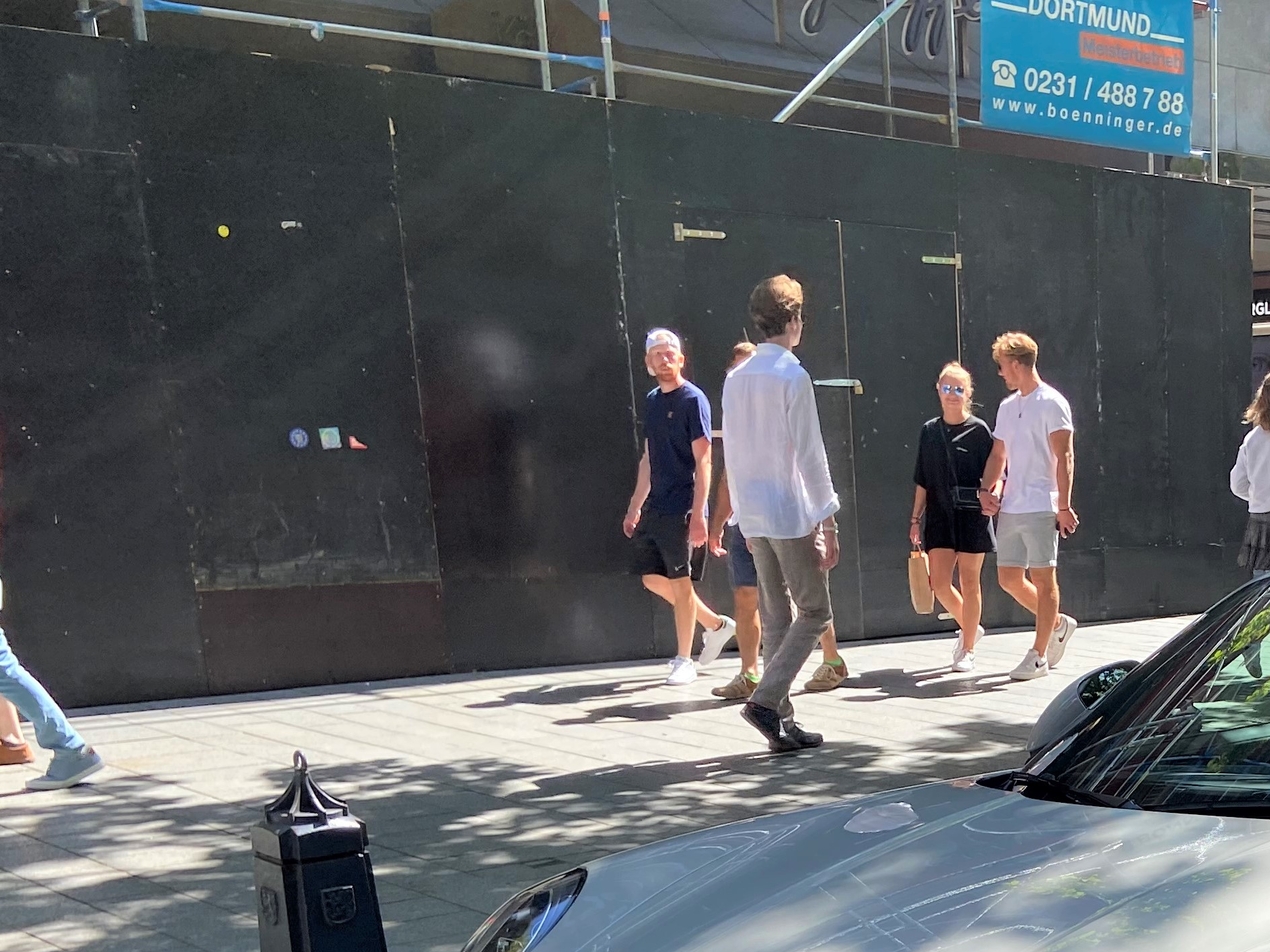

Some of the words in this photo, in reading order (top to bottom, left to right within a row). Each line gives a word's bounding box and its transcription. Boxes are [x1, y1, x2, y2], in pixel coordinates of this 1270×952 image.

[1027, 0, 1151, 37] DORTMUND
[1083, 38, 1184, 69] Meisterbetrieb
[1024, 67, 1077, 98] 0231
[1083, 77, 1093, 101] /
[1097, 81, 1137, 107] 488
[1142, 88, 1155, 110] 7
[1158, 91, 1184, 115] 88
[992, 97, 1182, 138] www.boenninger.de
